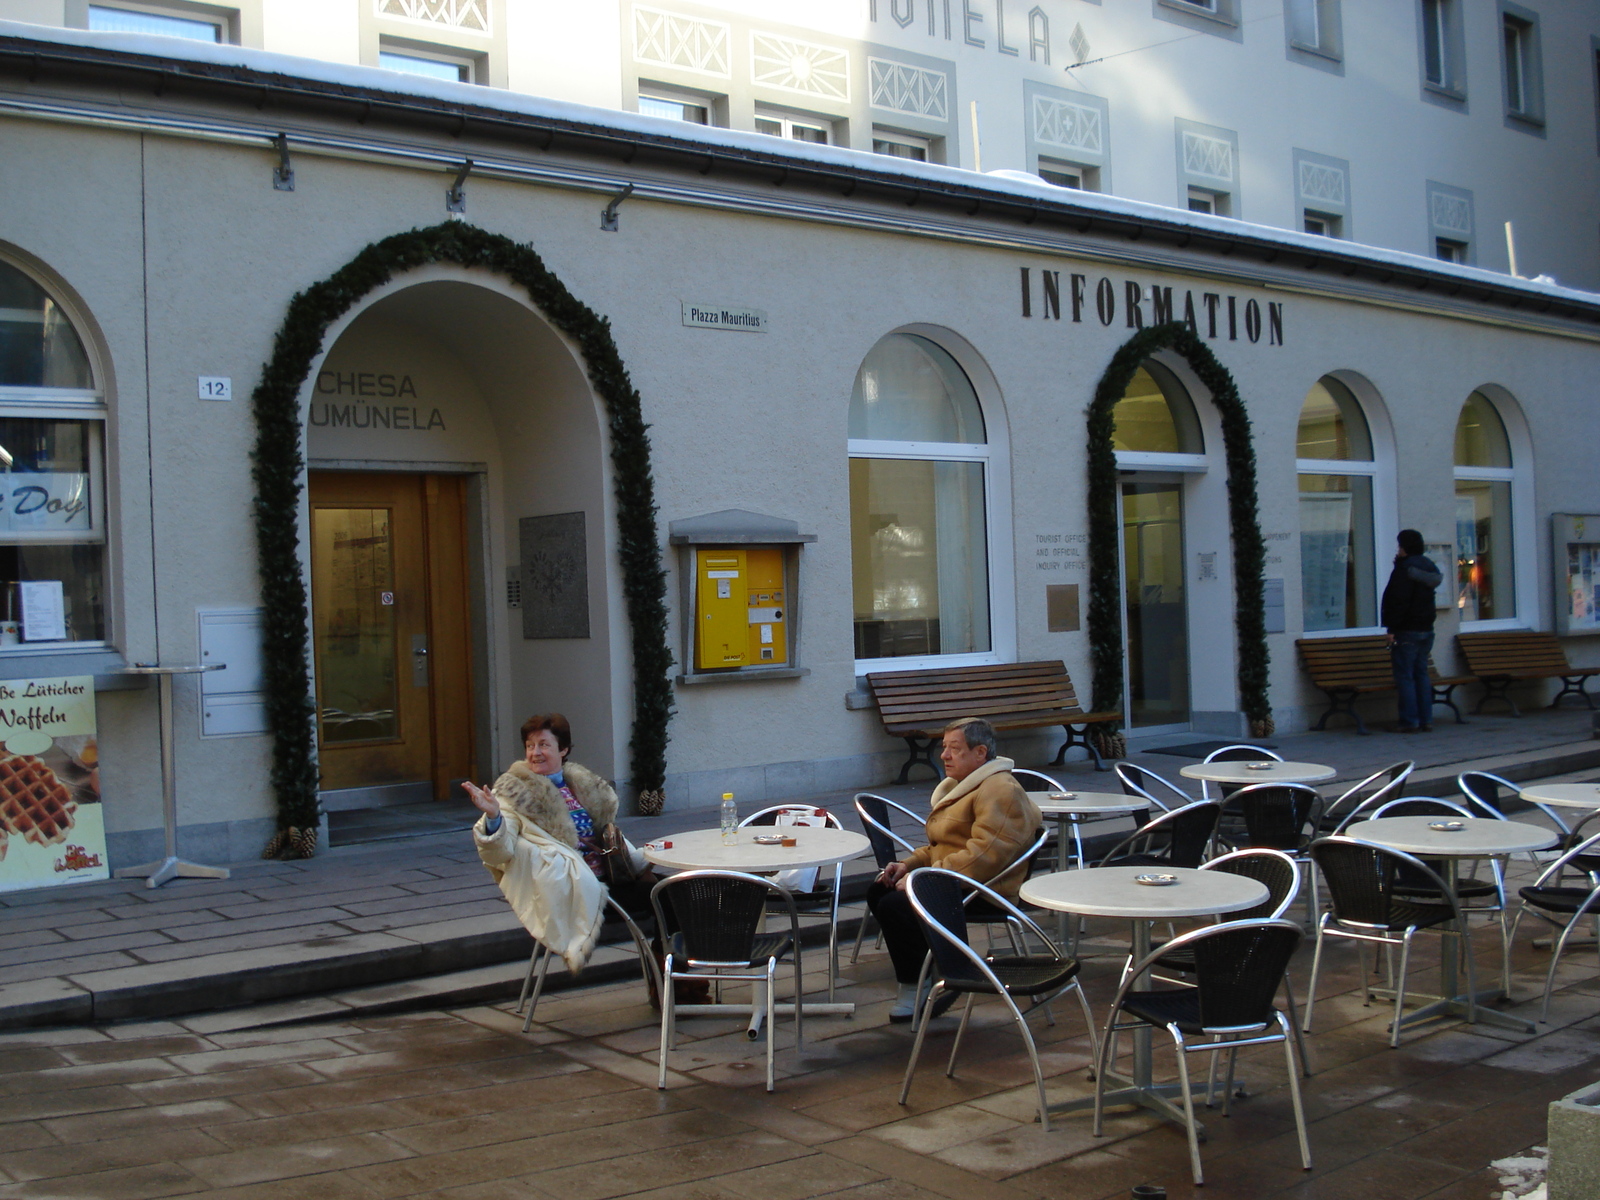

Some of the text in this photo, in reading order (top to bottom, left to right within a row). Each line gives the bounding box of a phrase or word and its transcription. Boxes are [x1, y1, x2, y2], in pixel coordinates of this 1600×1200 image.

[691, 307, 760, 327] Plazza Mauritius
[1019, 266, 1284, 346] INFORMATION
[205, 381, 225, 396] 12
[316, 371, 417, 398] CHESA
